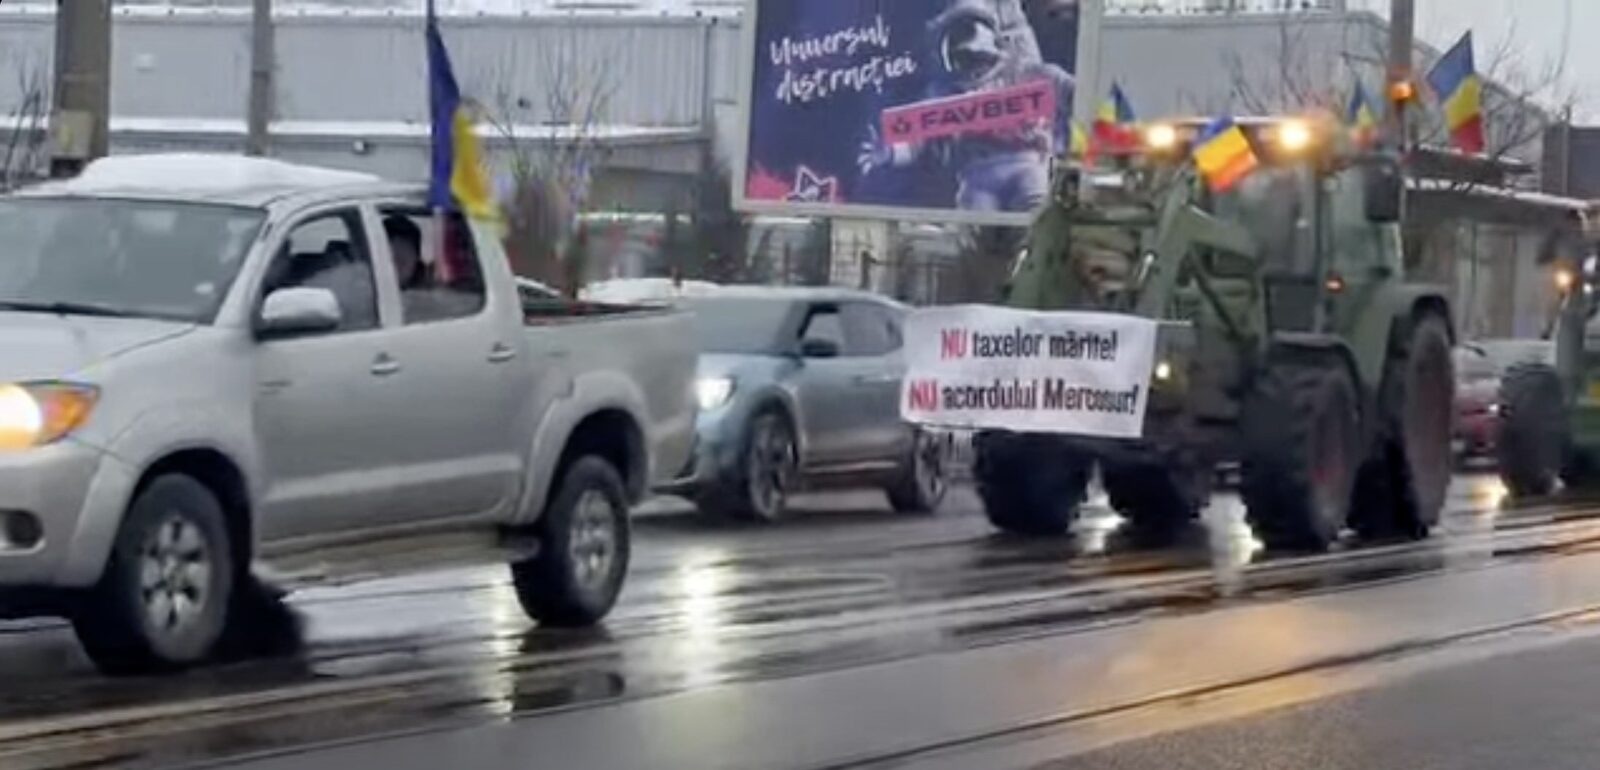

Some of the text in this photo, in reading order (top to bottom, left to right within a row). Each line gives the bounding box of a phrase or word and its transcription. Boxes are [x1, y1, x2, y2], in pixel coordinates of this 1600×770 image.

[769, 15, 891, 65] Universul
[920, 91, 1045, 130] FAVBET
[940, 328, 967, 360] NU
[972, 327, 1043, 358] taxelor
[908, 378, 1139, 415] NU acordului Mercosur!
